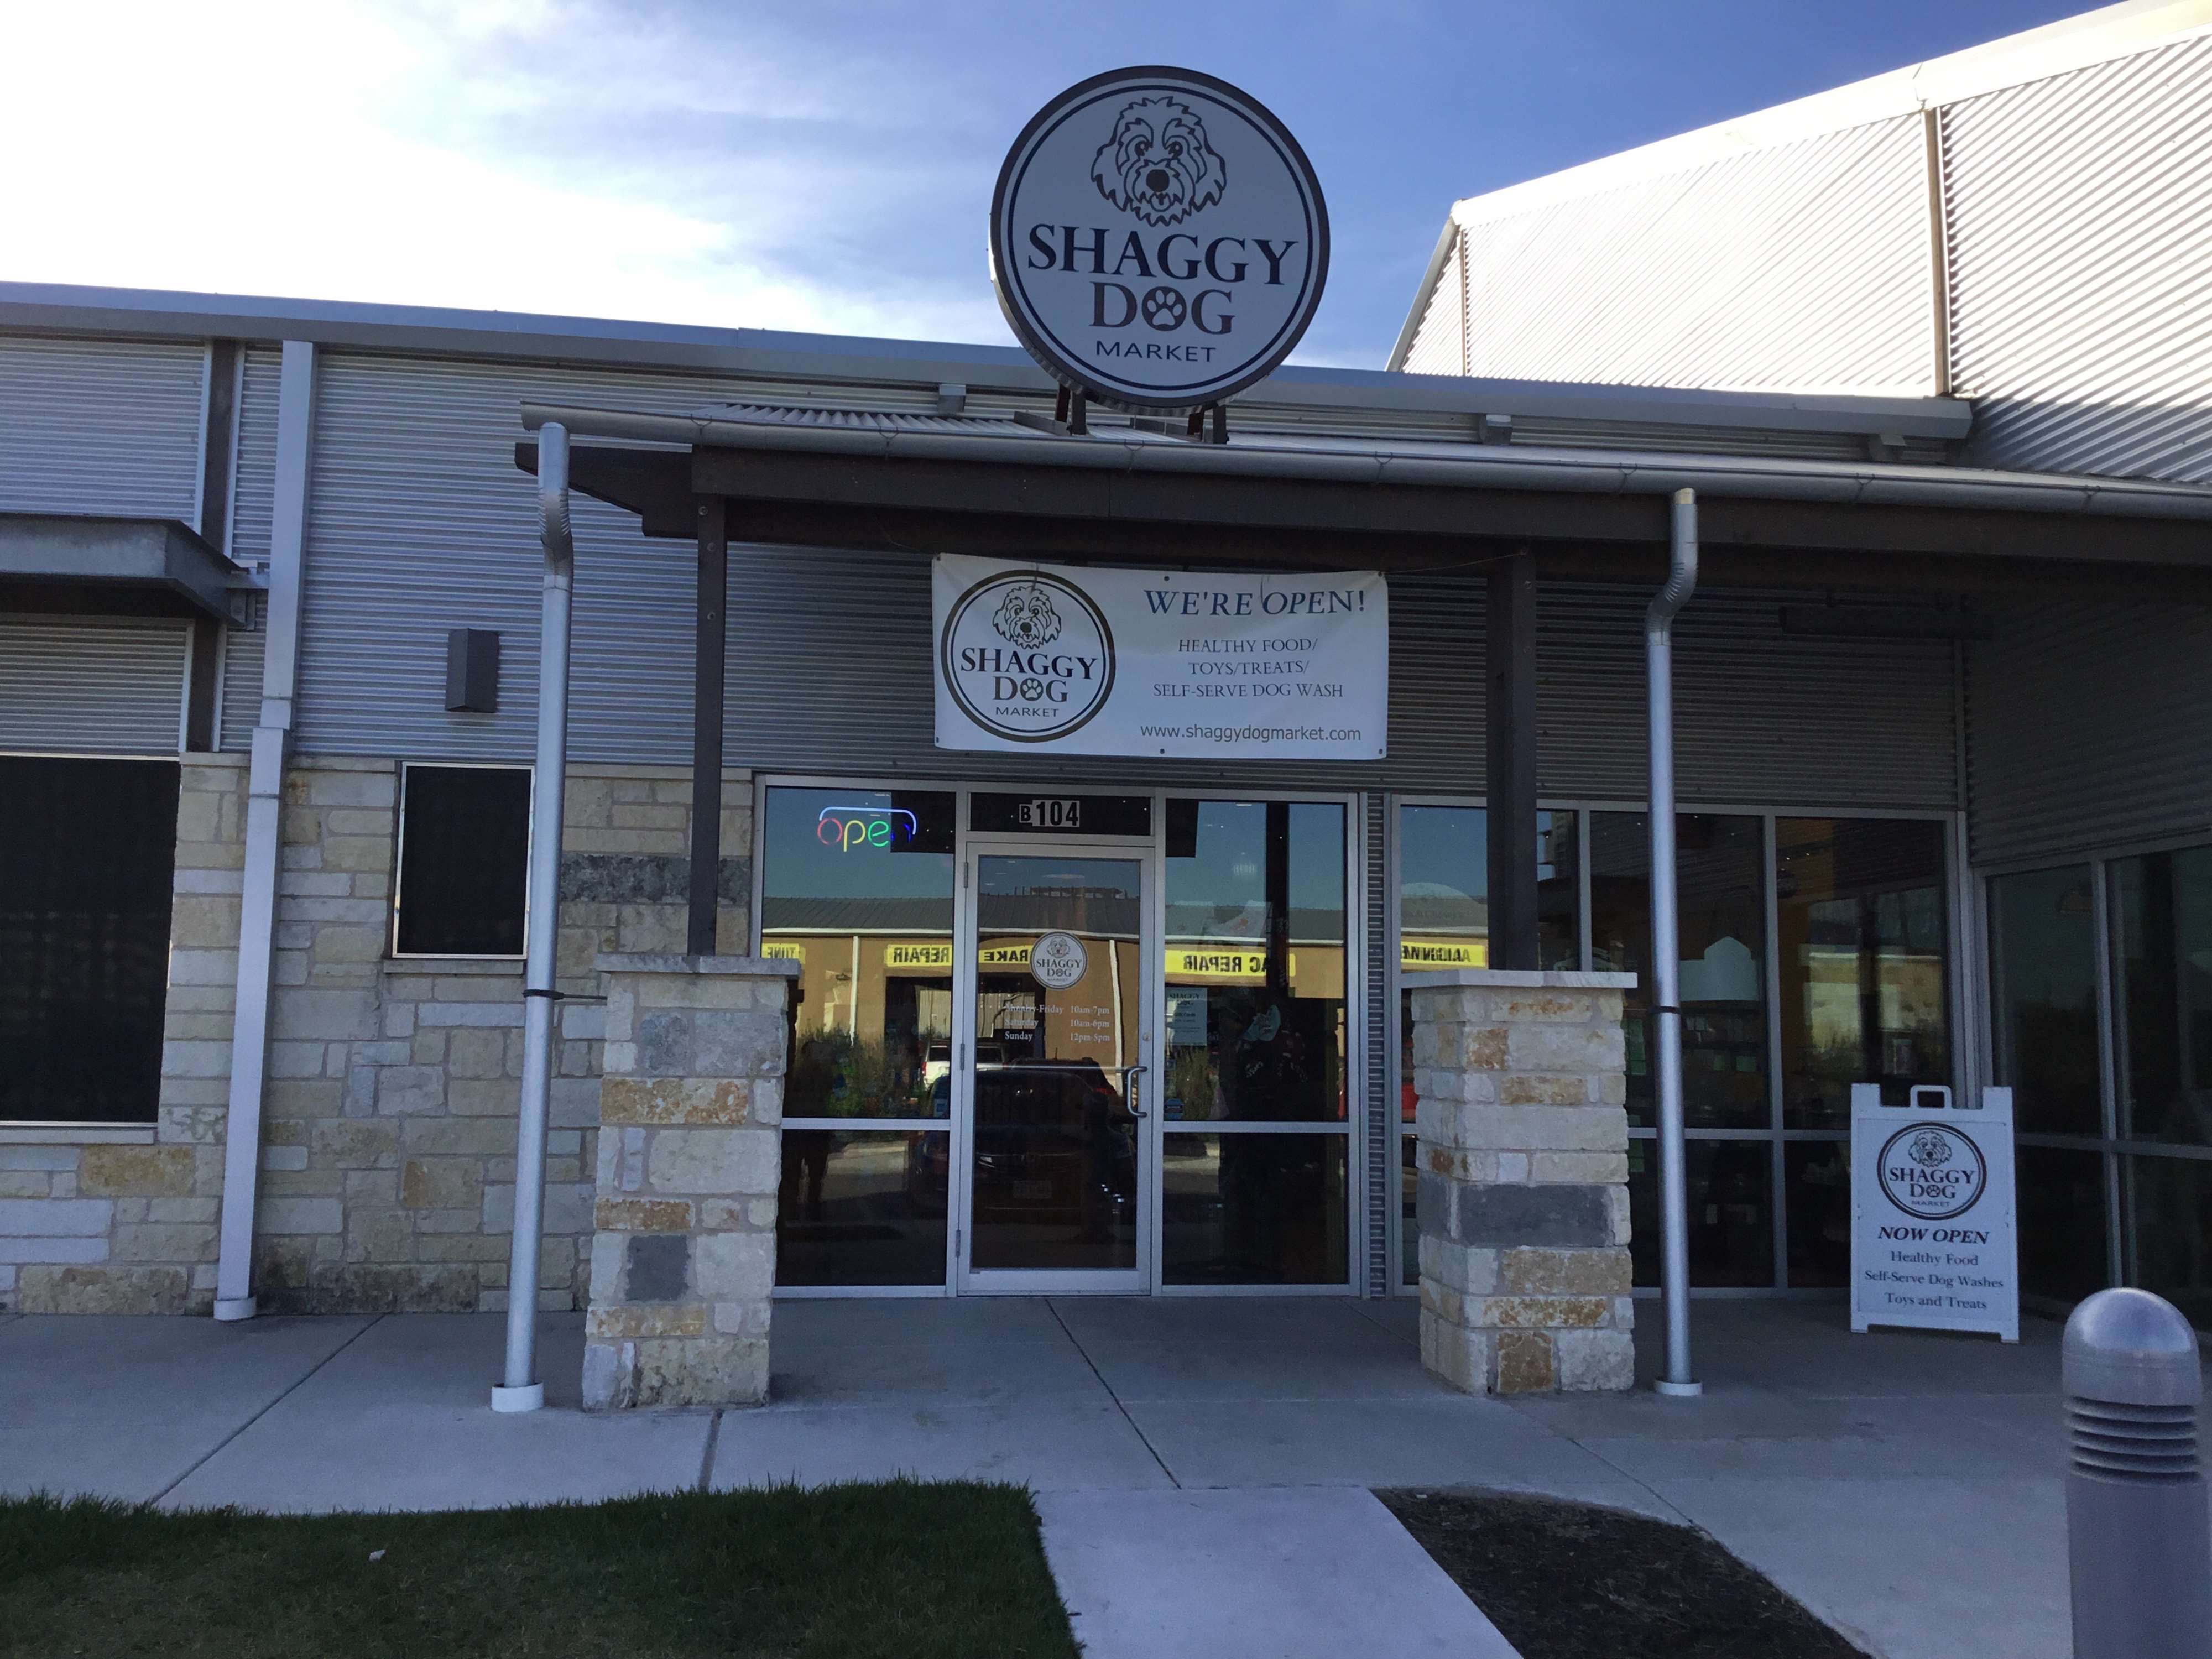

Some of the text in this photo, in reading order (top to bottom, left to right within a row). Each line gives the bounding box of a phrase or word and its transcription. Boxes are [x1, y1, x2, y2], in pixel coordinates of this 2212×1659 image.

[1028, 223, 1299, 285] SHAGGY
[1089, 280, 1236, 335] DOG
[1097, 341, 1216, 363] MARKET
[1144, 589, 1365, 616] WE'RE OPEN!
[1178, 638, 1318, 653] HEALTHY FOOD/
[961, 647, 1098, 680] SHAGGY
[1188, 660, 1309, 675] TOYS/TREATS/
[992, 676, 1068, 703] DOG
[1154, 683, 1343, 697] SELF-SERVE DOG WASH
[995, 706, 1060, 718] MARKET
[1140, 724, 1361, 742] www.shaggydogmarket.com
[1036, 959, 1082, 968] SHAGGY
[1047, 968, 1071, 977] DOG
[1070, 1005, 1110, 1015] 10am-7pm
[1005, 1018, 1110, 1029] Saturday 10am-6pm
[1005, 1031, 1110, 1043] Sunday 12pm-5pm
[1889, 1167, 1976, 1185] SHAGGY
[1910, 1183, 1955, 1199] DOG
[1879, 1226, 1990, 1245] NOW OPEN
[1891, 1251, 1979, 1267] Healthy Food
[1865, 1270, 2004, 1288] Self-Serve Dog Washes
[1885, 1292, 1986, 1310] Toys and Treats
